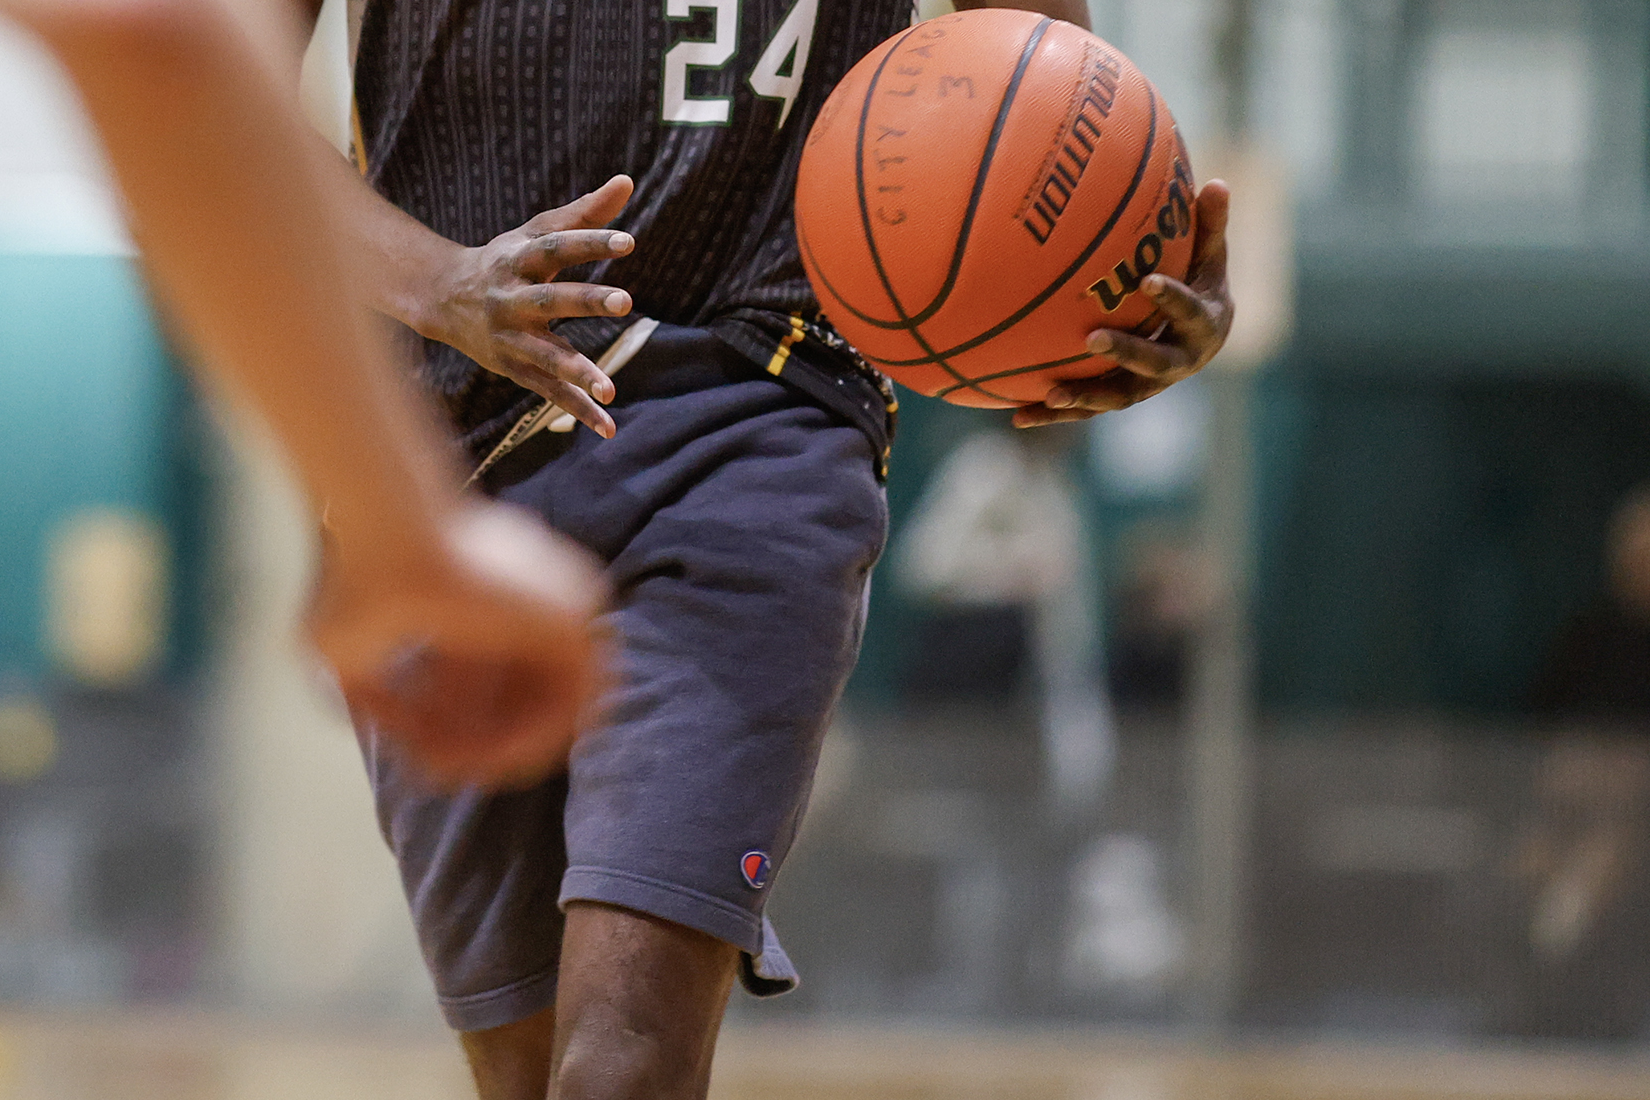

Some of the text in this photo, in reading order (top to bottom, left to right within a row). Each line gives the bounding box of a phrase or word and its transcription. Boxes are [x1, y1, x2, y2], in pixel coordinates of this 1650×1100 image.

[937, 74, 975, 99] 3
[873, 125, 908, 225] CITY
[1023, 51, 1121, 246] VOLUTION
